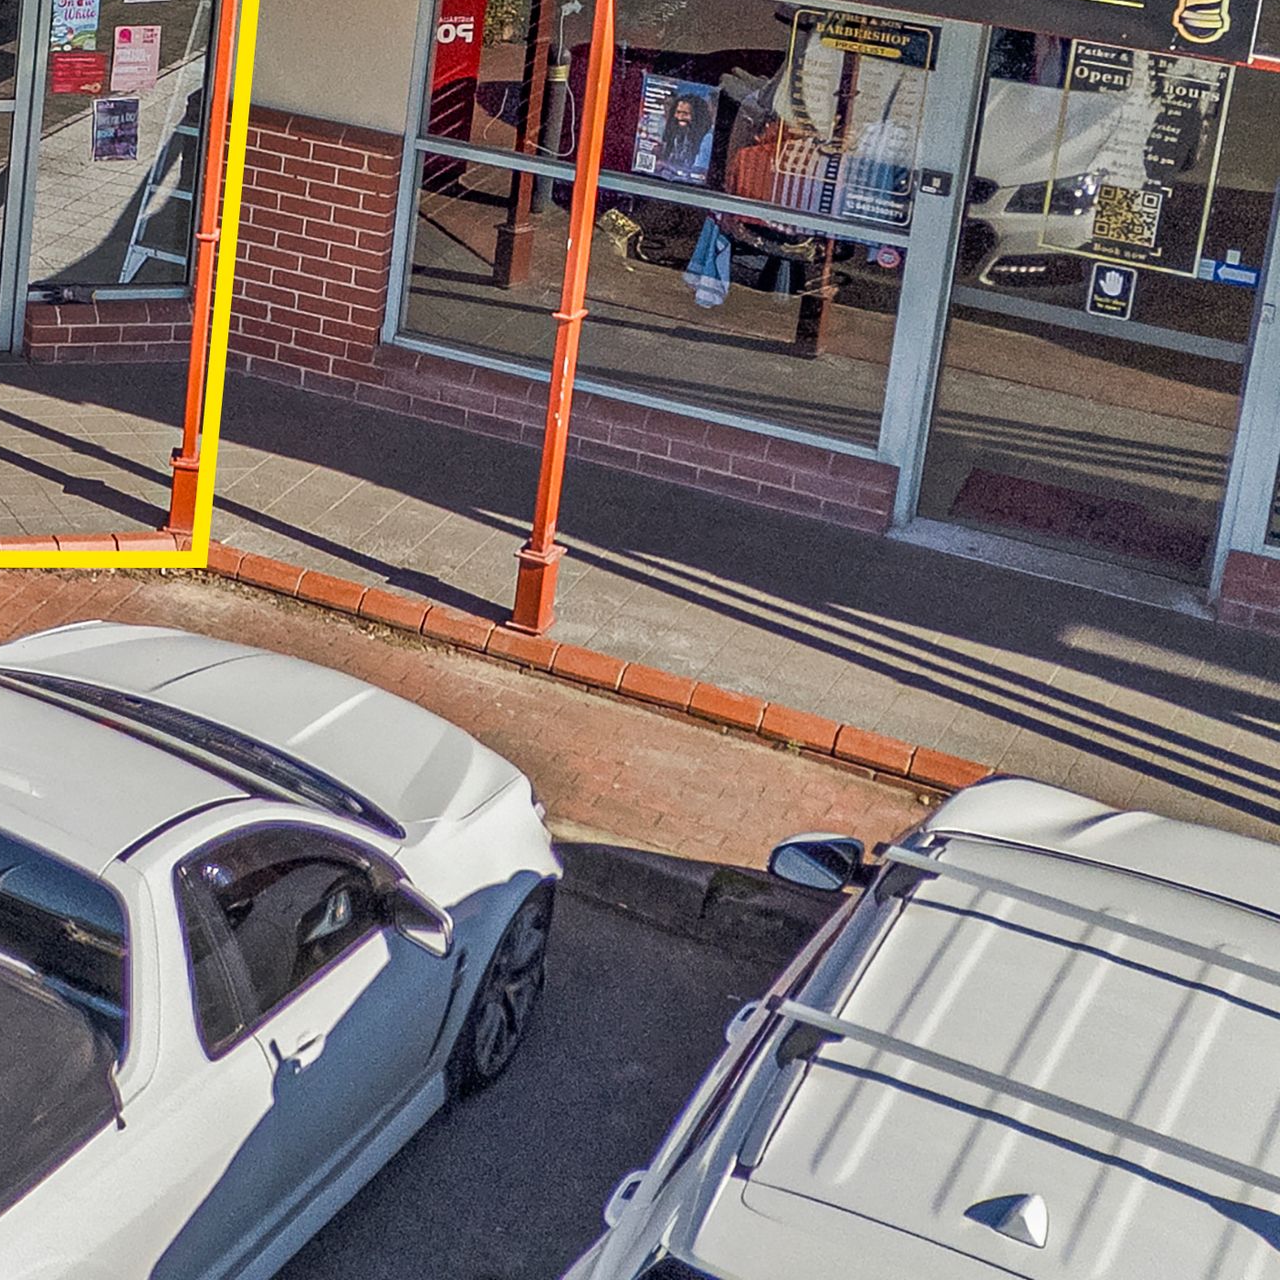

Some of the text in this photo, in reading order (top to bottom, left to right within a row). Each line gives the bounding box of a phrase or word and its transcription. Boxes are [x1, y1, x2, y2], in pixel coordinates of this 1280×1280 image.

[816, 22, 911, 47] BARBERSHOP
[1076, 45, 1118, 60] Father
[1163, 78, 1222, 103] hours
